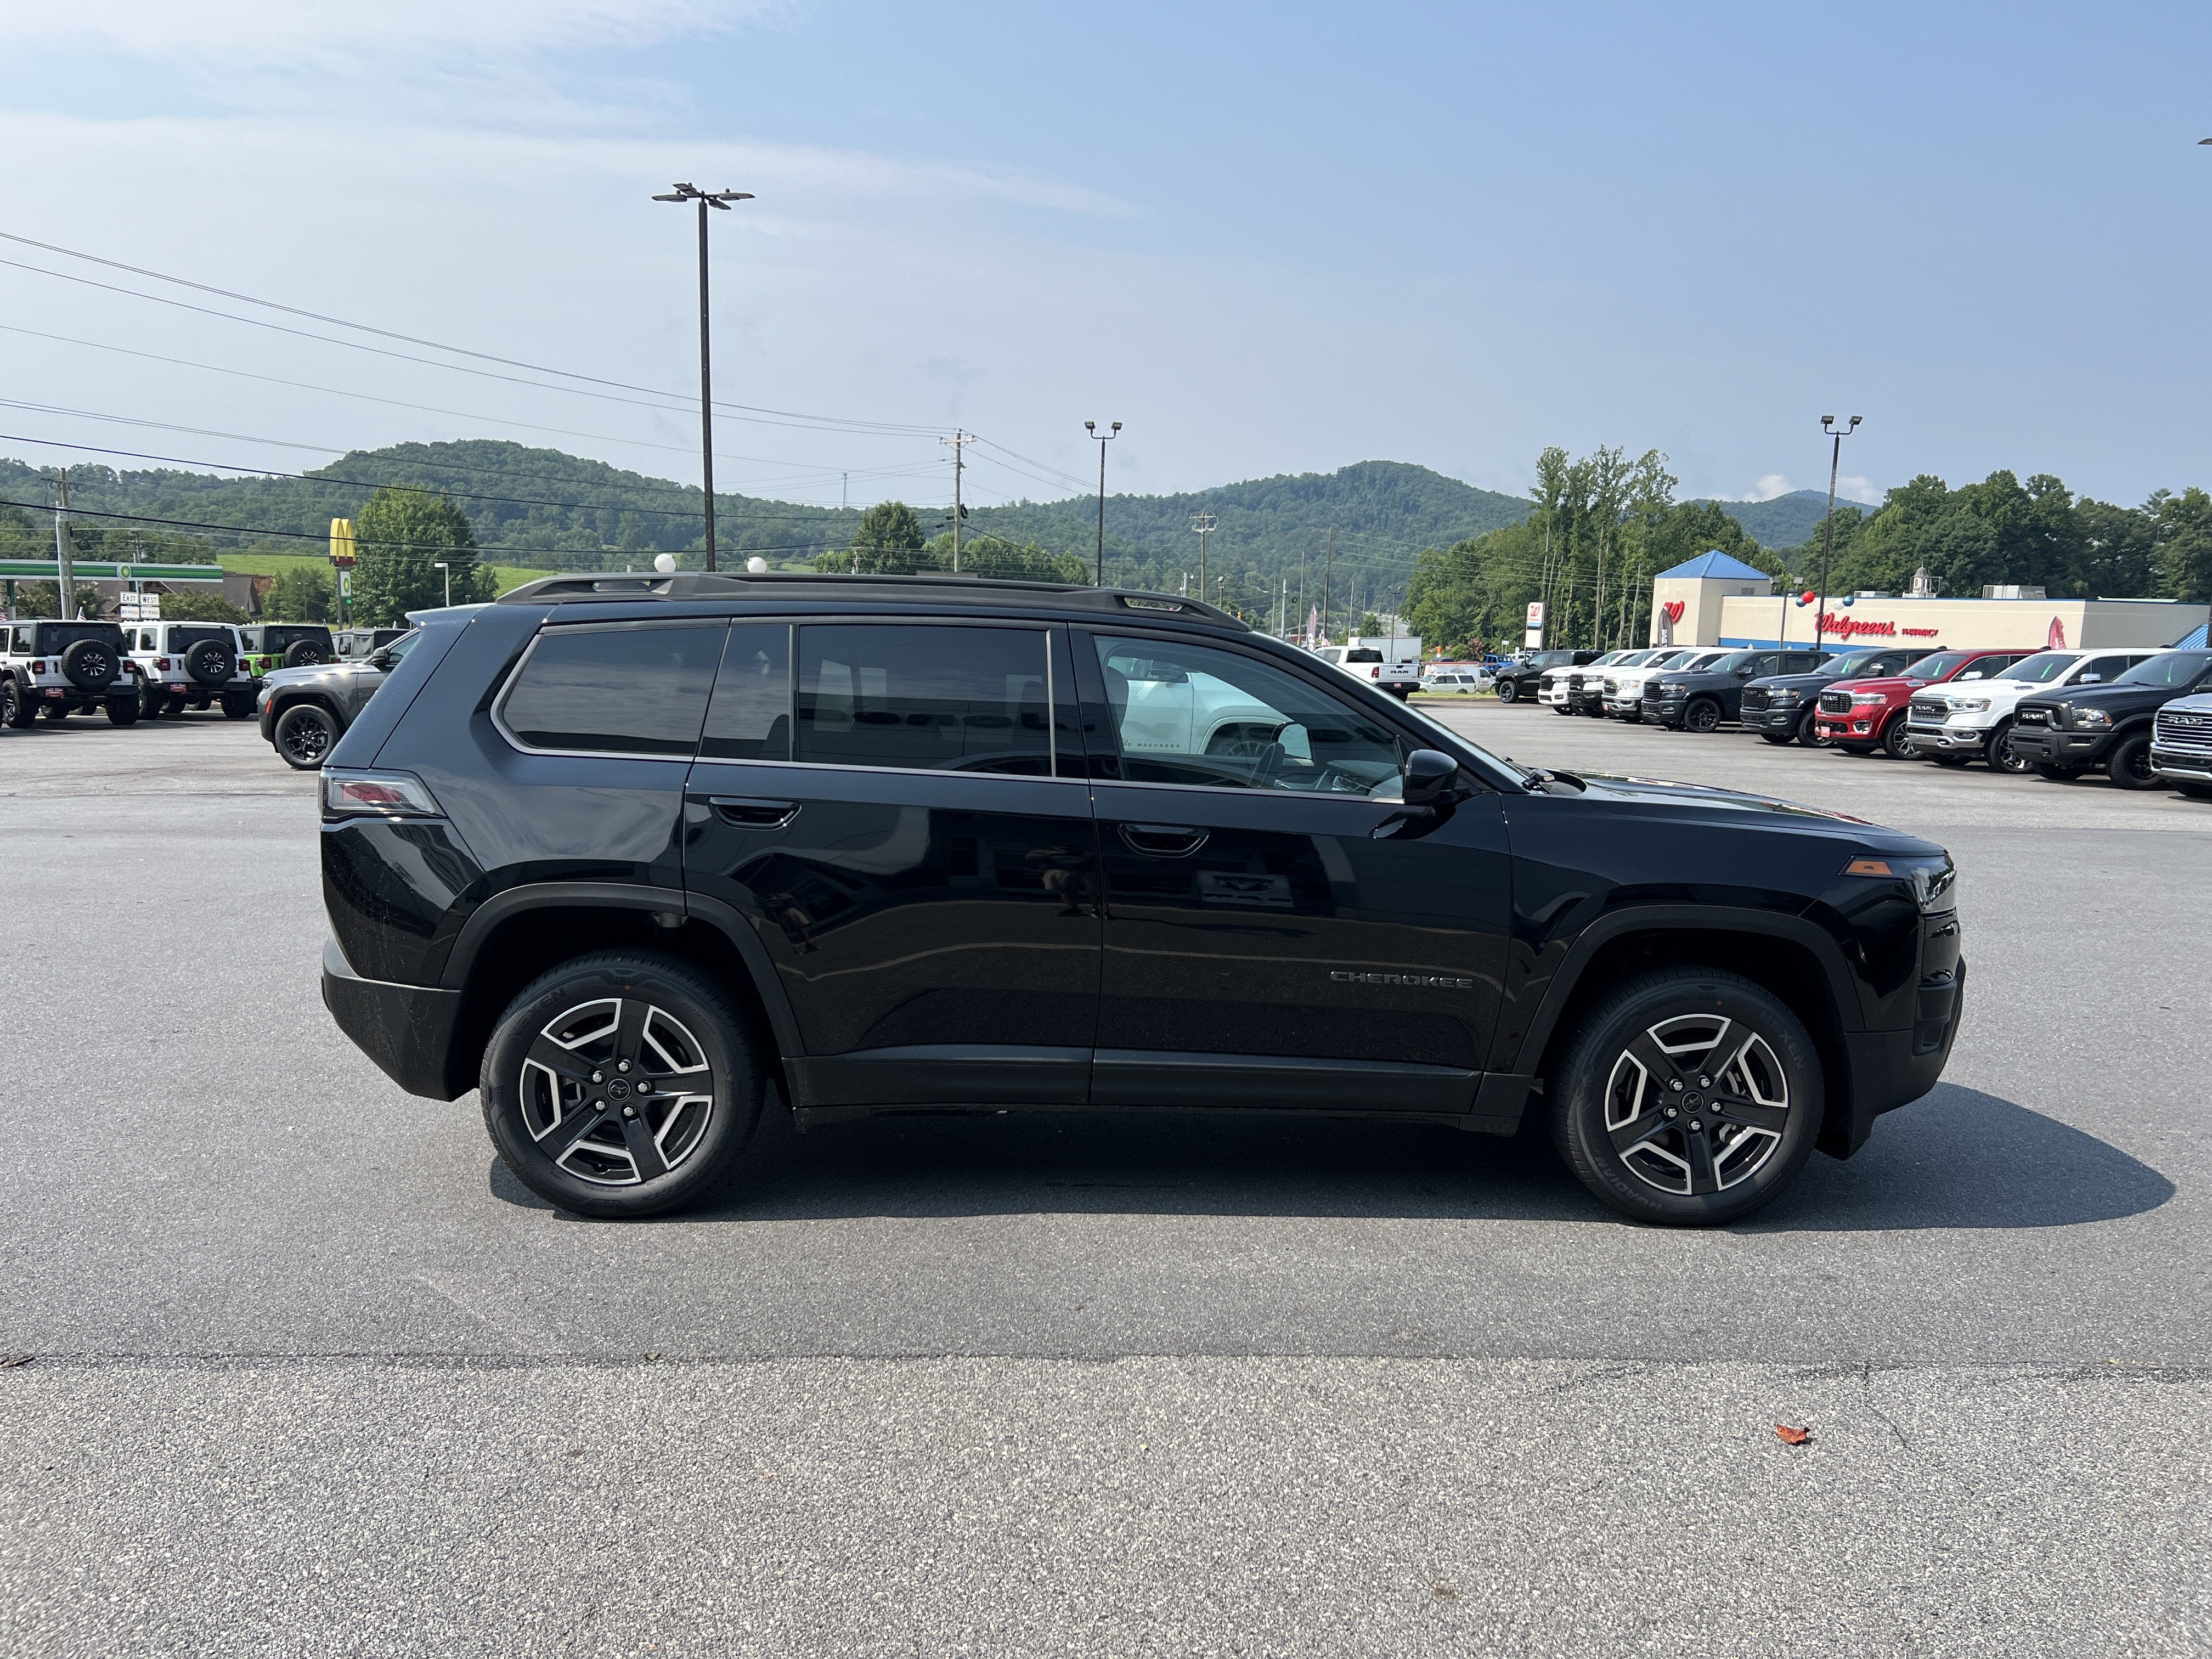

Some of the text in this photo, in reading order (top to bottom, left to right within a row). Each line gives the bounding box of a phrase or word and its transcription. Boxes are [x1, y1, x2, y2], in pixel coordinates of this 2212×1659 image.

[122, 594, 136, 602] EAST
[1815, 612, 1897, 640] Walgreens
[2168, 716, 2203, 725] RAM
[1330, 970, 1472, 988] CHEROKEE
[510, 987, 567, 1039] NEXEN
[1759, 1011, 1807, 1069] NEXEN
